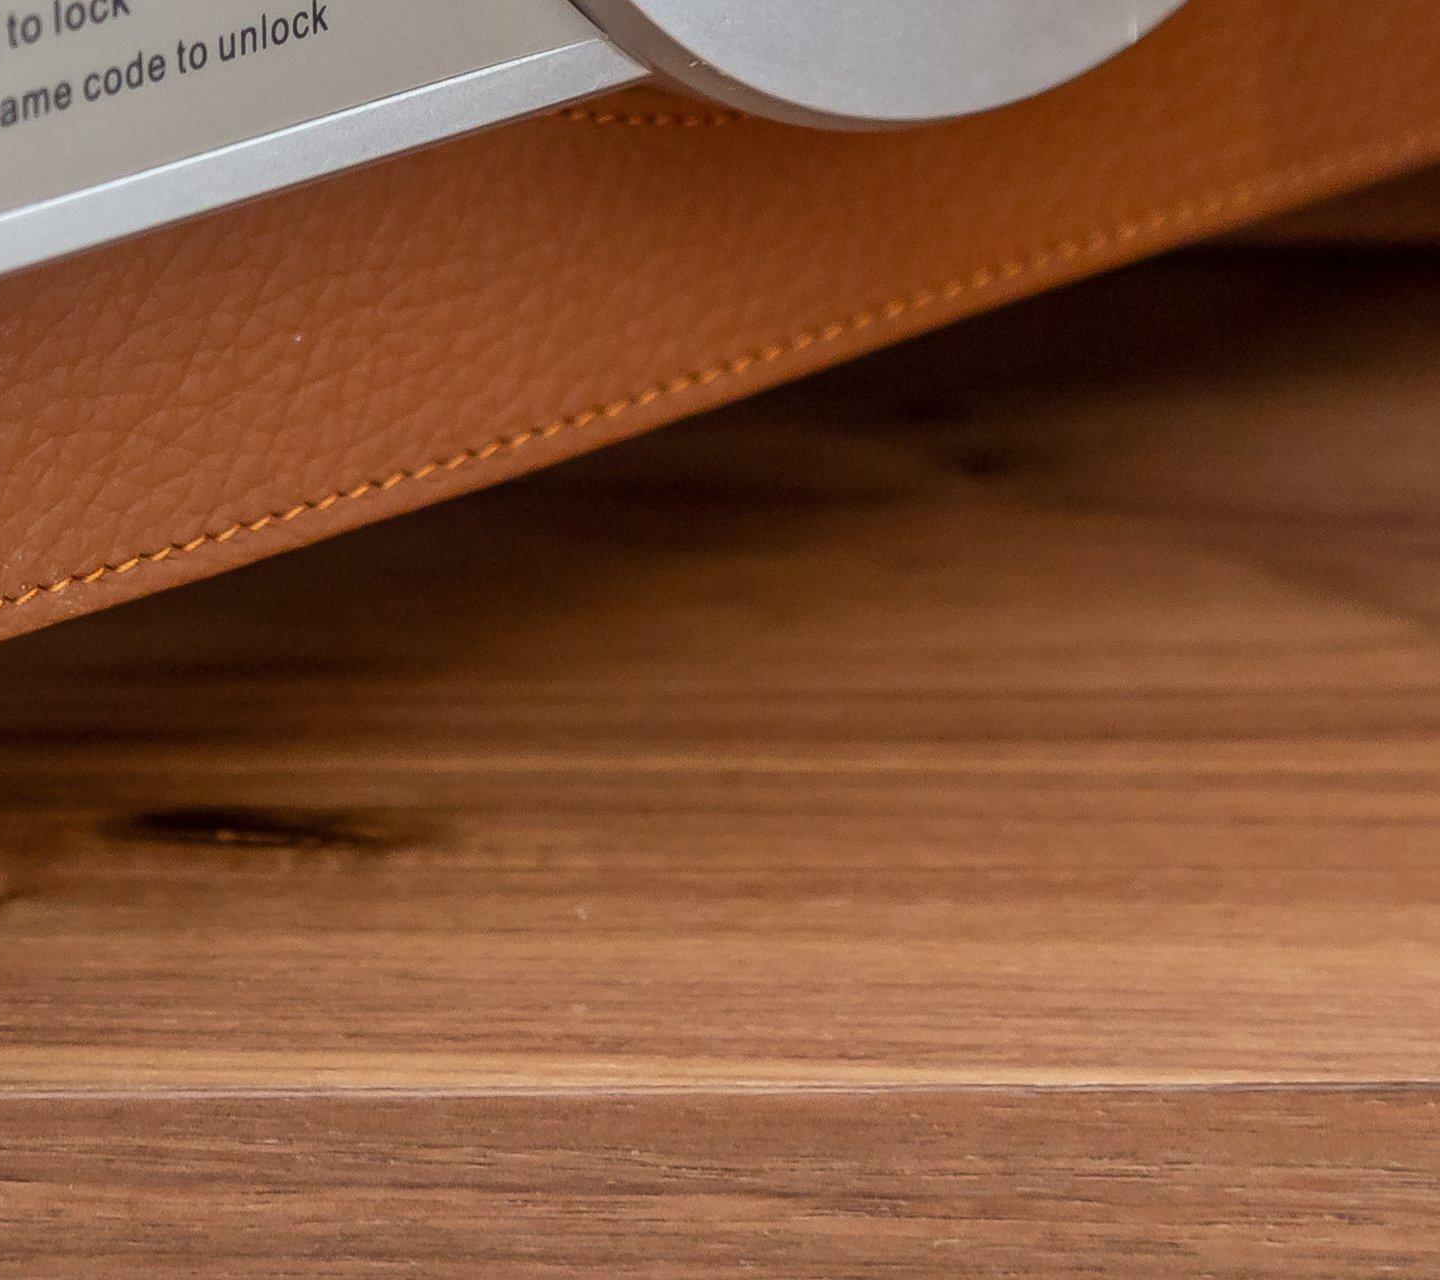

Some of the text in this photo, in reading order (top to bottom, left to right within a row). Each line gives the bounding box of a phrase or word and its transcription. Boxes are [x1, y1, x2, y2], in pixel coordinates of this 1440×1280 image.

[7, 10, 42, 48] to
[82, 51, 166, 102] code
[176, 39, 208, 74] to
